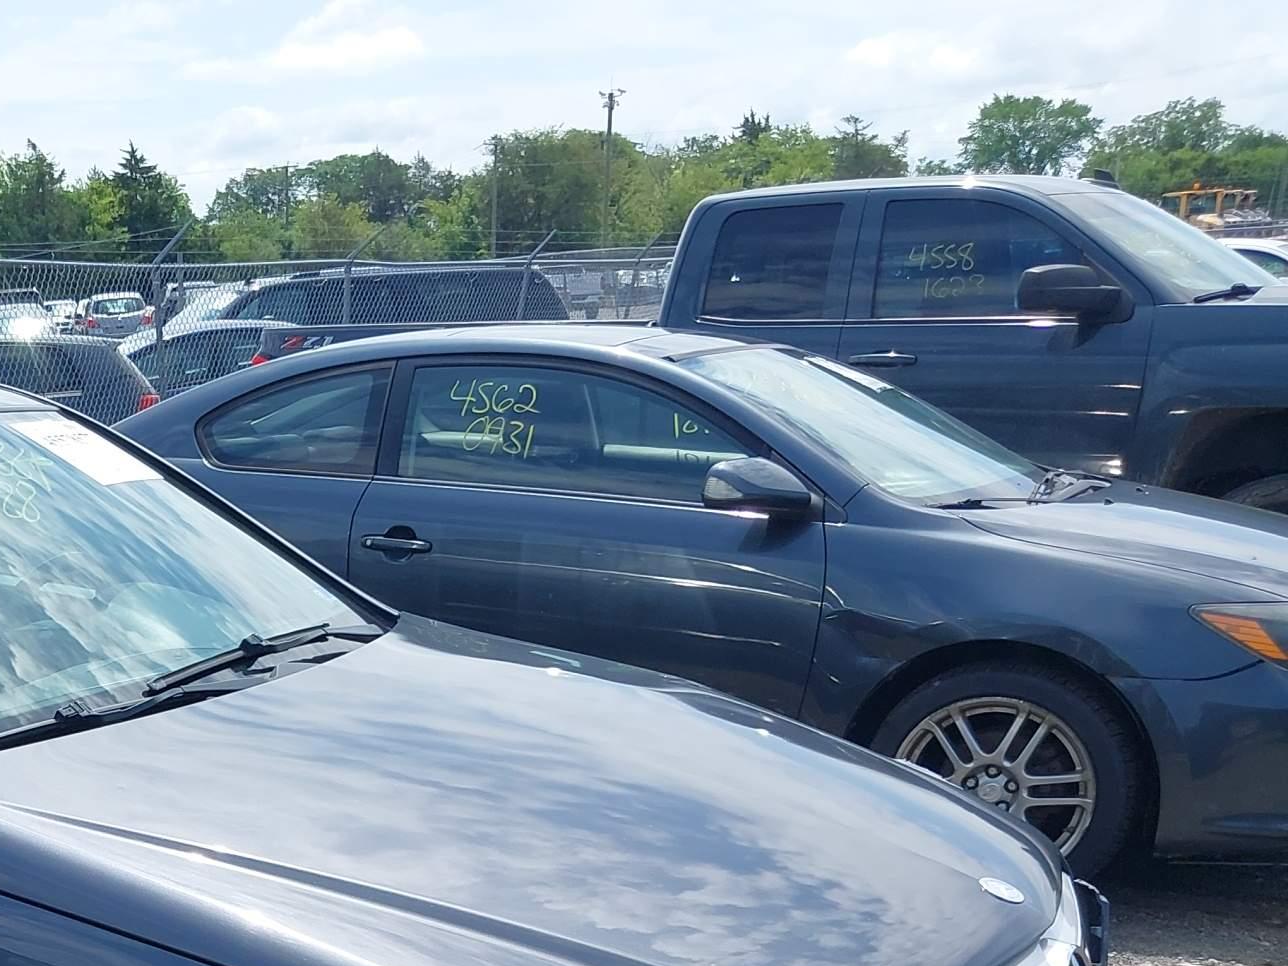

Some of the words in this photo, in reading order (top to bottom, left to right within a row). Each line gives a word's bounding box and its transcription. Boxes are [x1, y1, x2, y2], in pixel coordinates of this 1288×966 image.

[908, 243, 974, 272] 4558
[450, 379, 541, 417] 4562
[463, 416, 535, 459] 0931
